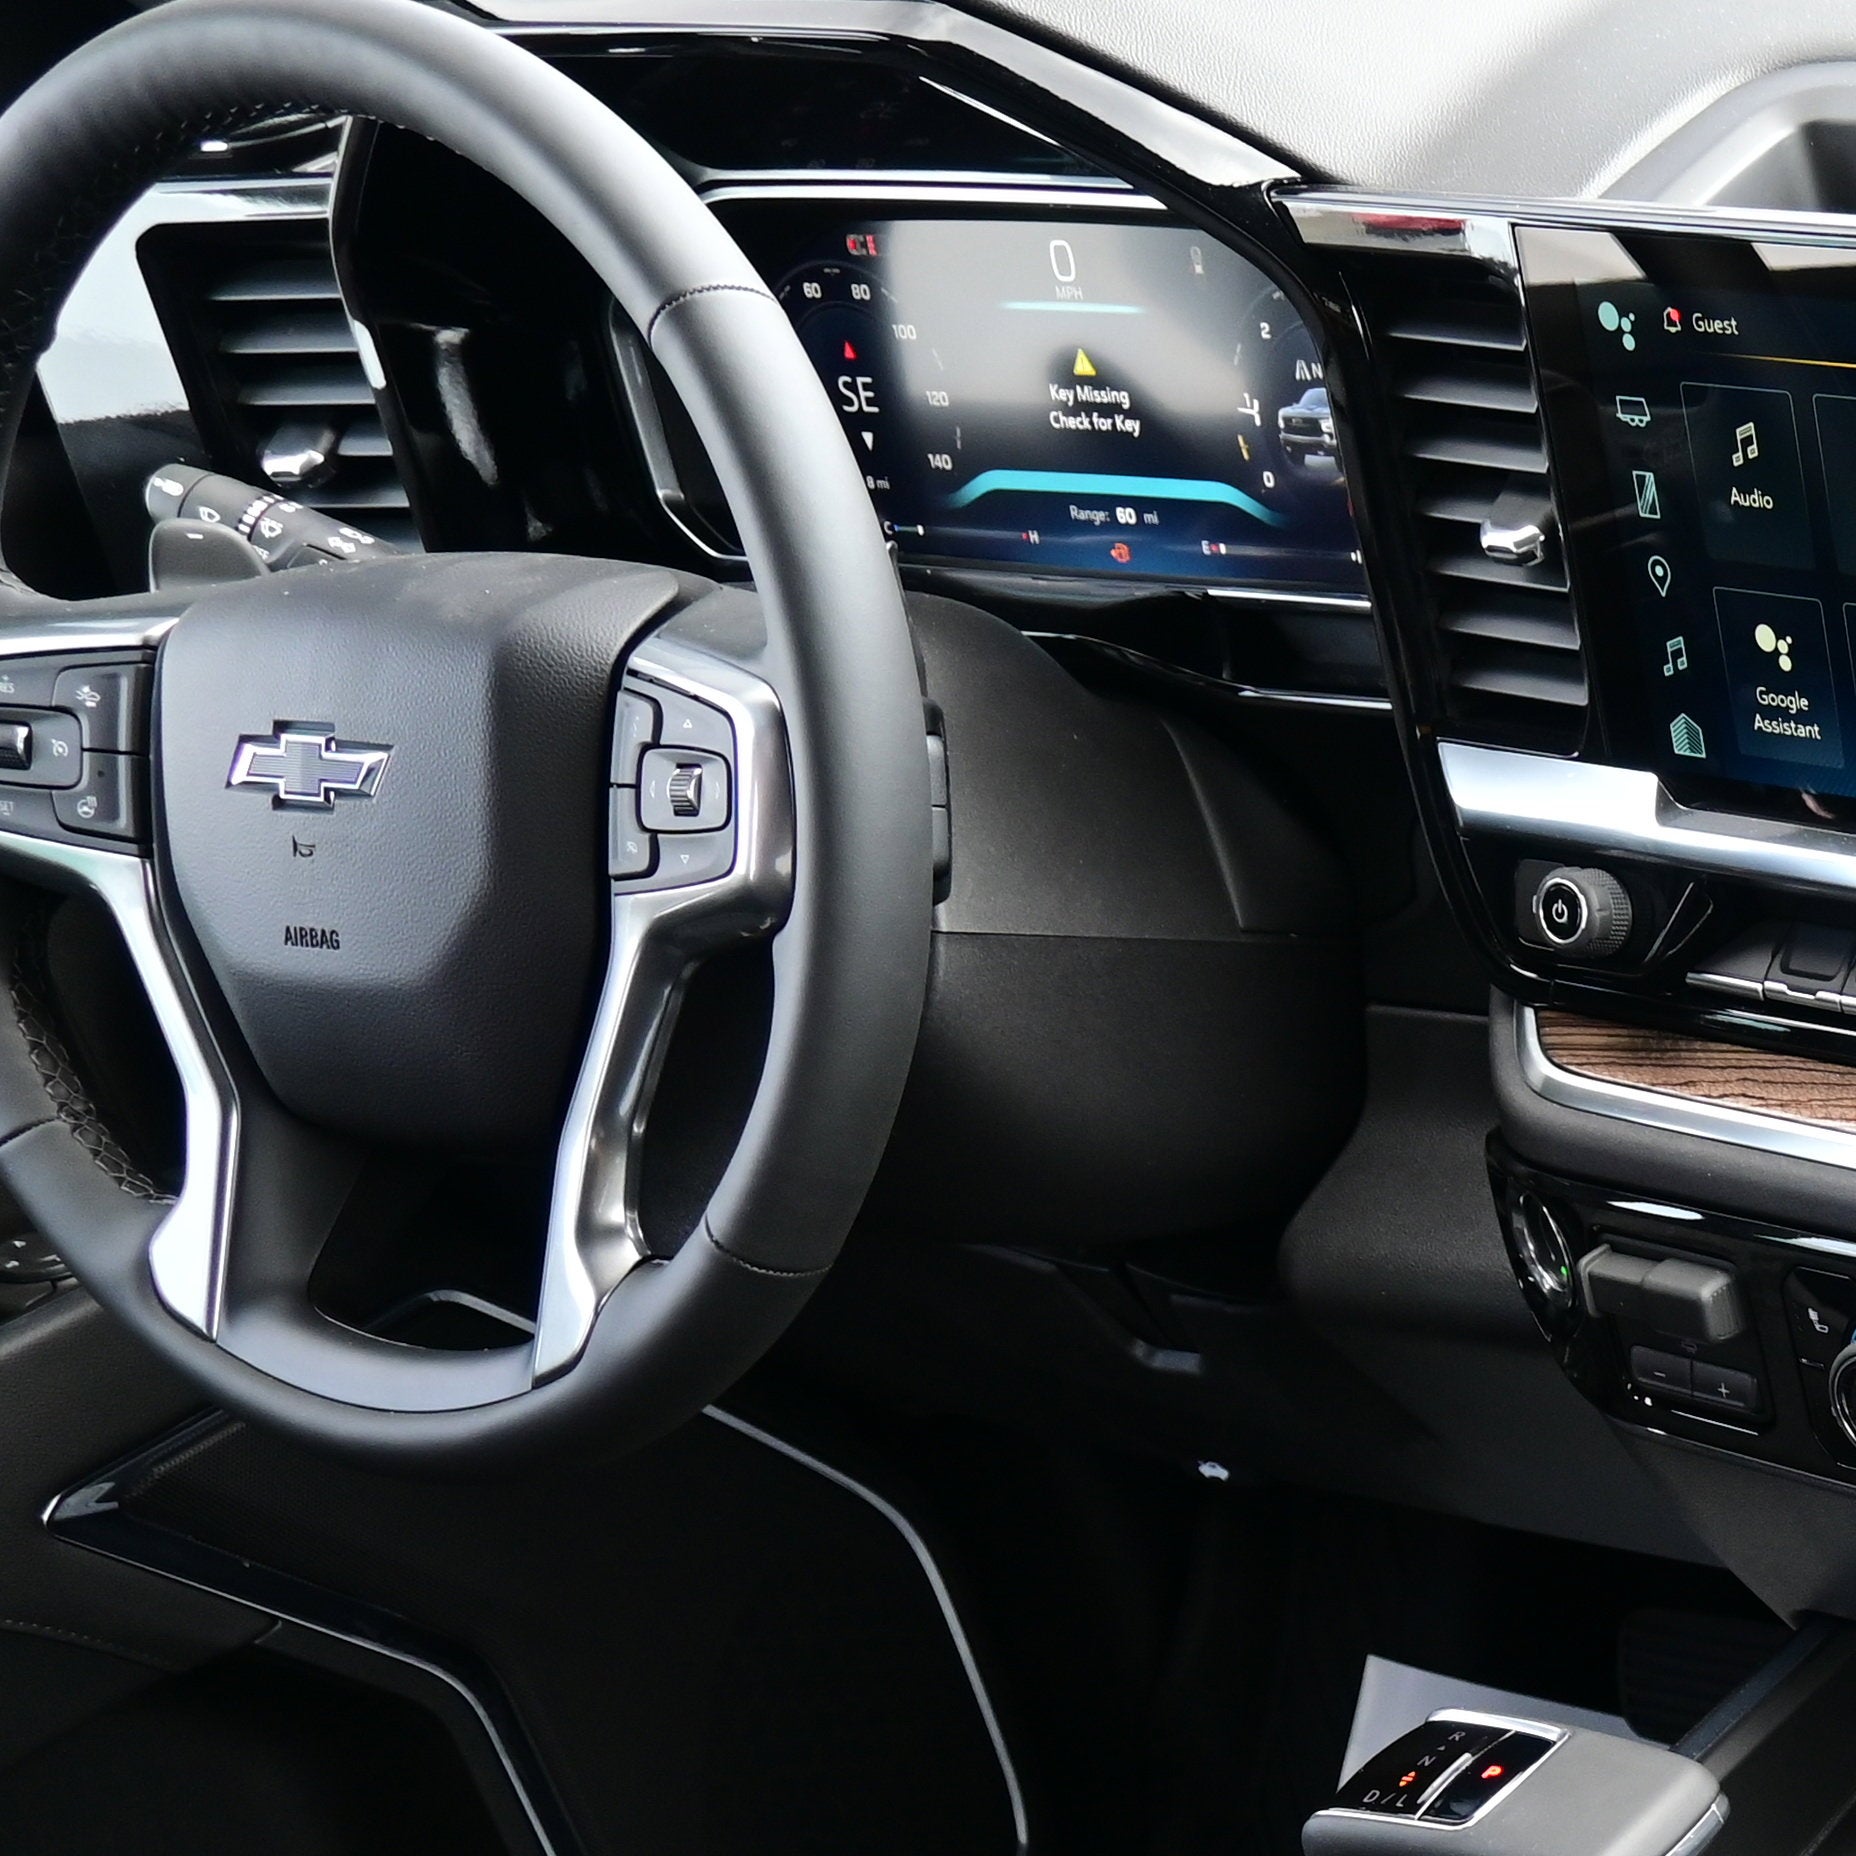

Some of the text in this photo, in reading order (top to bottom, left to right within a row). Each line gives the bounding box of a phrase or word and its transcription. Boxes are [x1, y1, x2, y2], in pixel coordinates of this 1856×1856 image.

[1050, 239, 1076, 282] 0
[803, 282, 821, 298] 60
[851, 284, 870, 300] 80
[1055, 286, 1083, 301] MPH
[892, 324, 917, 340] 100
[1260, 322, 1272, 339] 2
[1692, 313, 1739, 336] Guest
[838, 376, 879, 413] SE
[926, 391, 949, 407] 120
[1049, 383, 1130, 409] Key Missing
[1049, 410, 1140, 437] Check for Key
[928, 453, 952, 471] 140
[1263, 471, 1275, 488] 0
[1730, 487, 1773, 511] Audio
[1069, 505, 1160, 526] Range: 60 mi
[1028, 530, 1039, 544] H
[1755, 687, 1809, 714] Google
[1754, 714, 1821, 741] Assistant
[284, 925, 341, 951] AIRBAG
[1448, 1731, 1466, 1742] R
[1416, 1755, 1436, 1767] N
[1481, 1765, 1502, 1779] P
